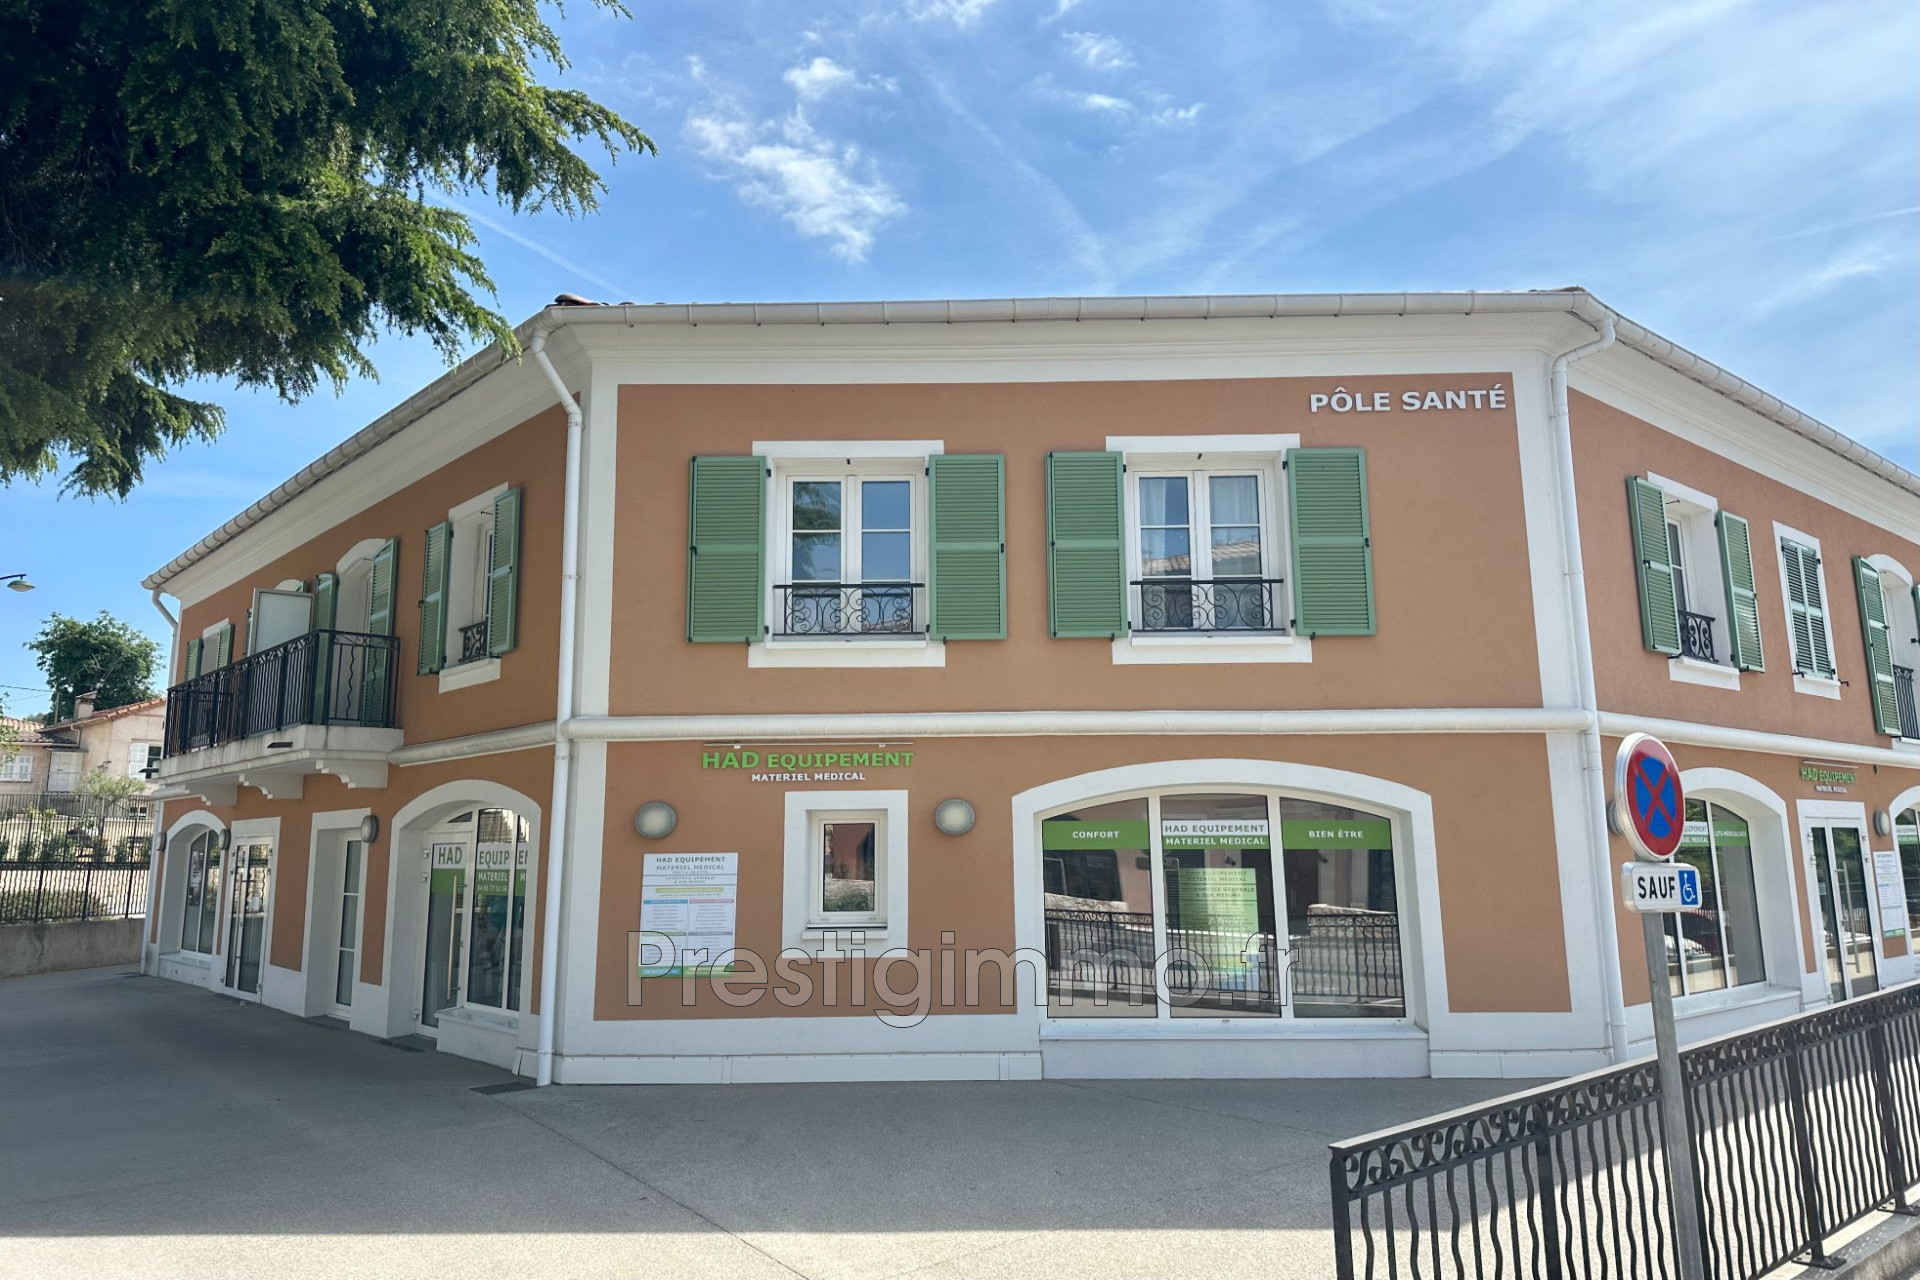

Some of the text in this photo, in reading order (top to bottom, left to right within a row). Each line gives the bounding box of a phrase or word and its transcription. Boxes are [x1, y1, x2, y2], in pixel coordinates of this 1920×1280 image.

[1310, 383, 1506, 413] PÔLE SANTÉ
[702, 752, 914, 771] HAD EQUIPEMENT
[752, 772, 866, 783] MATERIEL MEDICAL
[1801, 767, 1857, 784] HAD EQUIPEMENT
[1072, 830, 1120, 838] CONFORT
[1164, 824, 1265, 834] HAD EQUIPEMENT
[1308, 828, 1364, 838] BIEN ÊTRE
[1165, 837, 1266, 845] MATERIEL MEDICAL
[438, 846, 463, 865] HAD
[675, 856, 726, 864] EQUIPEMENT
[478, 871, 509, 881] MATERIEL
[1637, 876, 1676, 899] SAUF
